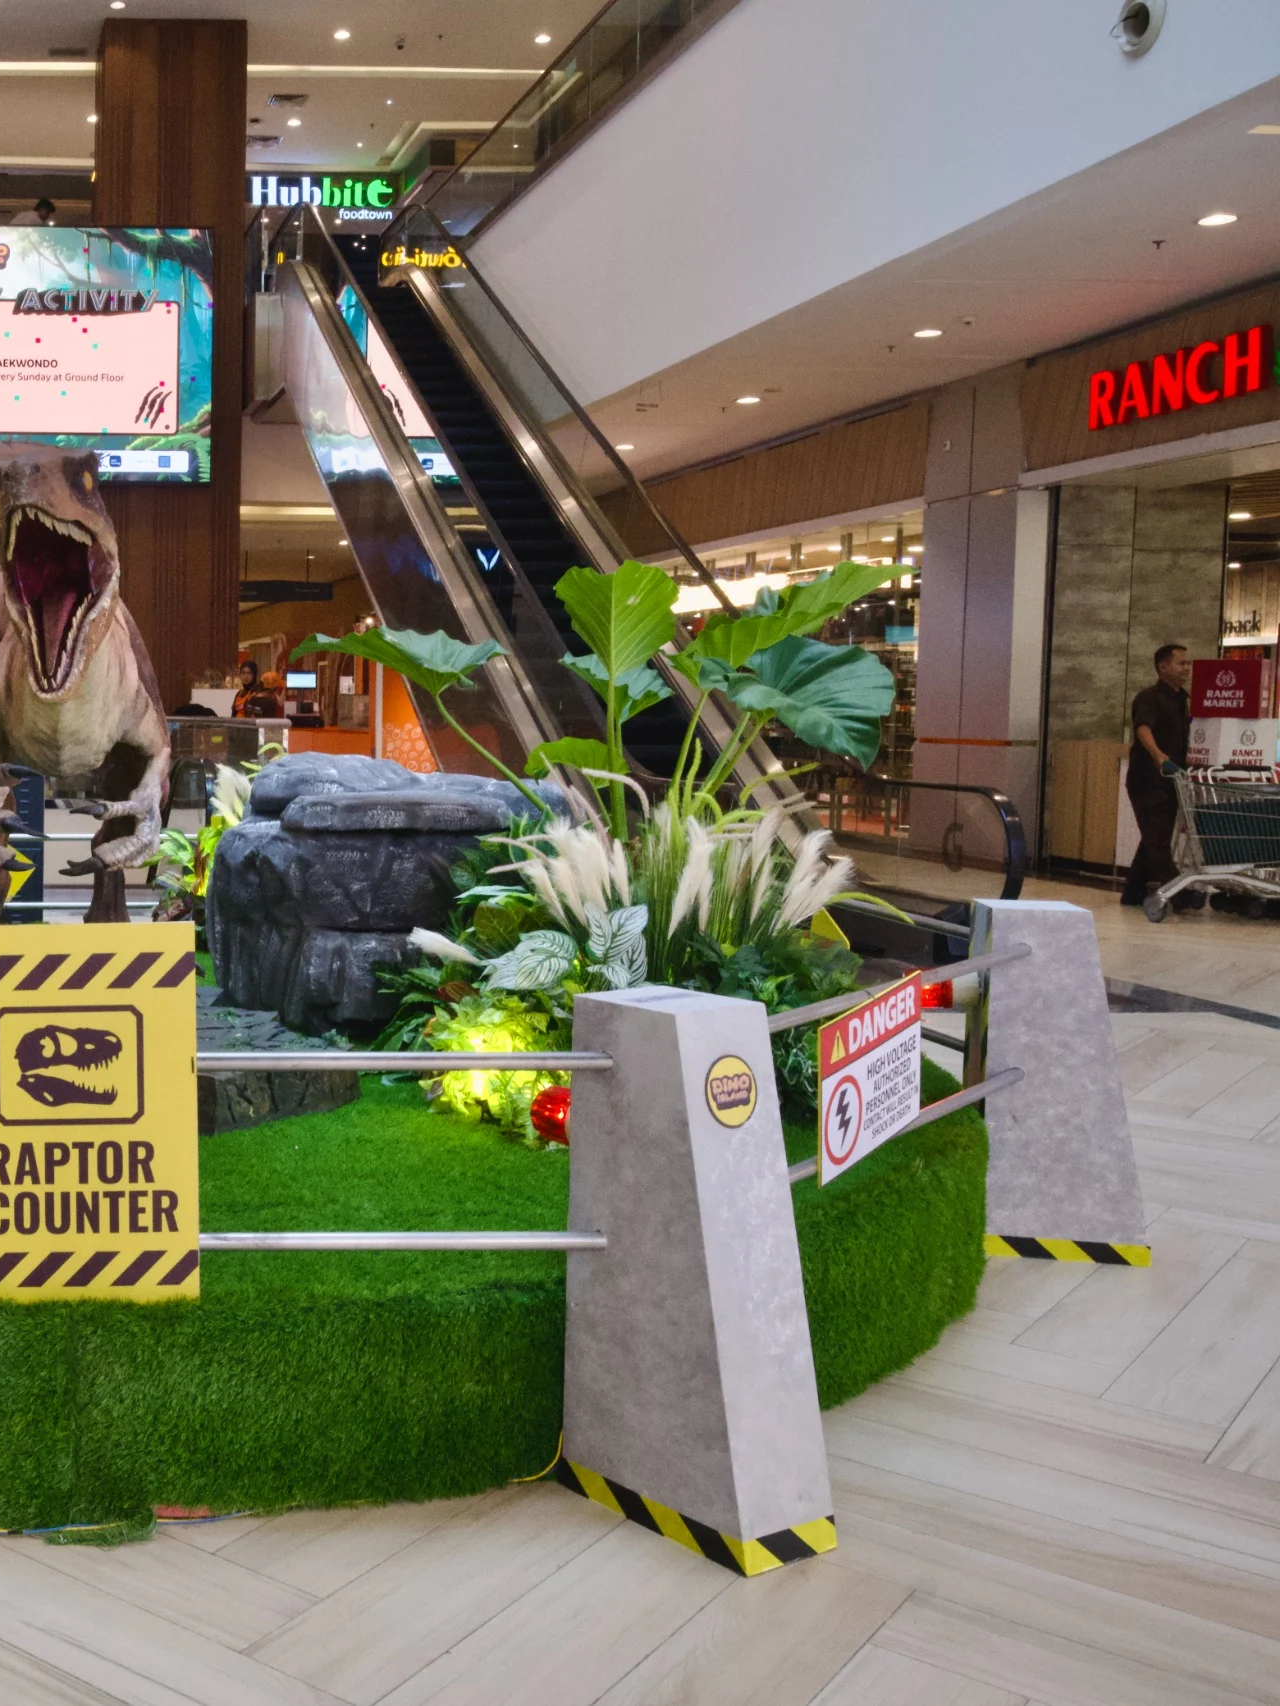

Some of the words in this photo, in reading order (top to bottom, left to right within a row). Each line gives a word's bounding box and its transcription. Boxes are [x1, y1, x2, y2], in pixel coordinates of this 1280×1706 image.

[339, 208, 393, 220] foodtown
[20, 287, 160, 312] ACTIVITY
[17, 372, 51, 382] Sunday
[53, 373, 62, 381] at
[65, 373, 99, 382] Ground
[101, 373, 125, 382] Floor
[1088, 325, 1265, 431] RANCH
[1203, 699, 1245, 708] MARKET
[1206, 689, 1244, 698] RANCH
[1231, 748, 1263, 757] RANCH
[848, 984, 916, 1054] DANGER
[866, 1053, 885, 1081] HIGH
[886, 1034, 917, 1067] VOLTAGE
[711, 1074, 750, 1096] DINO
[873, 1057, 911, 1094] AUTHORIZED
[716, 1090, 748, 1104] ISLAND
[865, 1082, 900, 1116] PERSONNEL
[901, 1069, 917, 1090] ONLY
[863, 1107, 886, 1131] CONTACT
[886, 1100, 897, 1115] WILL
[897, 1087, 913, 1107] RESULT
[871, 1121, 888, 1139] SHOCK
[895, 1104, 911, 1122] DEATH
